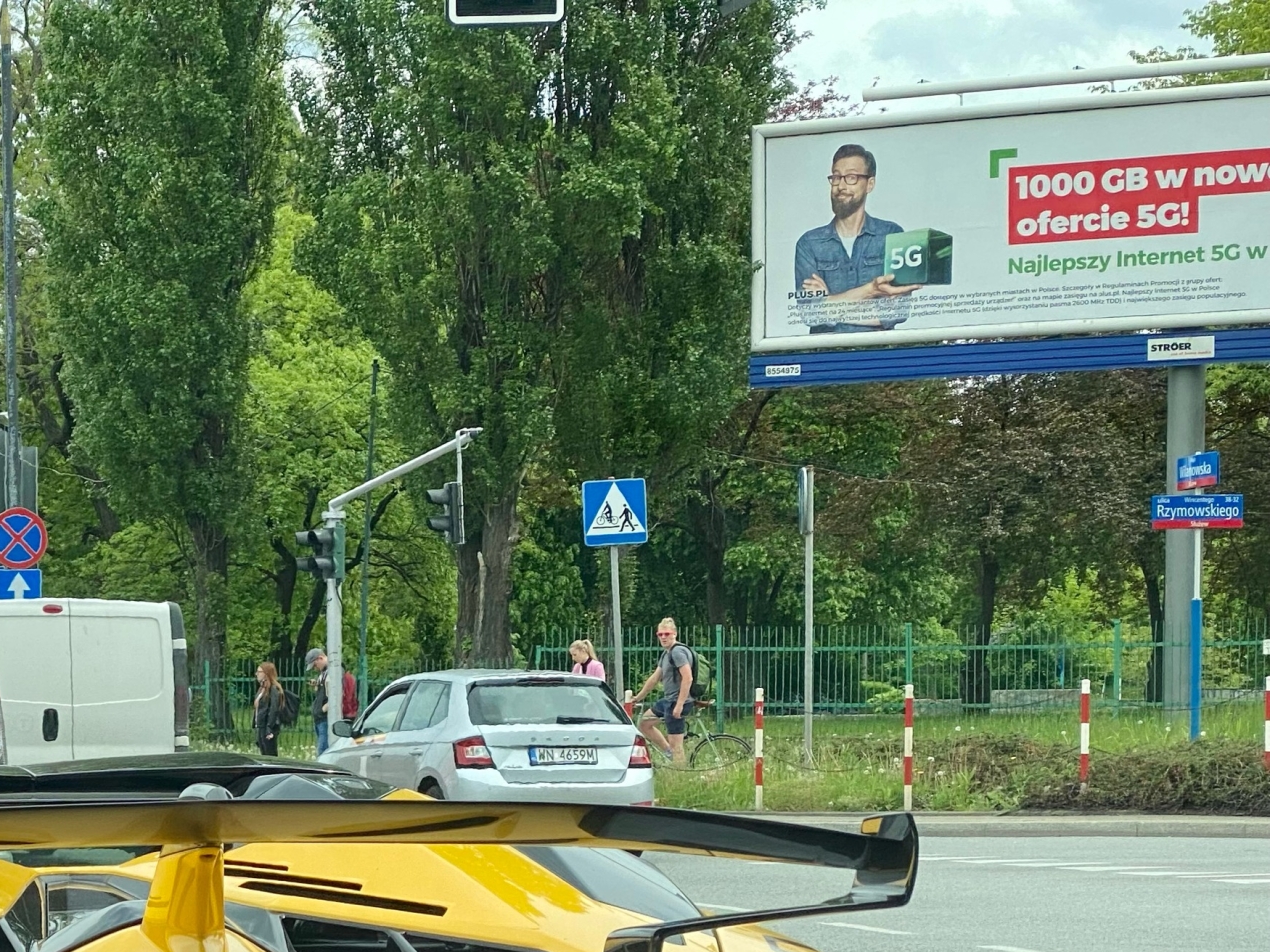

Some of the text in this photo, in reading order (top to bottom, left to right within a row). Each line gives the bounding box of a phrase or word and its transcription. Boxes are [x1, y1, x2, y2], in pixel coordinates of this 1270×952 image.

[1015, 162, 1270, 200] 1000 GB w now
[1016, 201, 1190, 237] ofercie 5G!
[890, 245, 923, 270] 5G
[1007, 243, 1269, 277] Najlepszy Internet 5G w
[787, 289, 829, 300] PLUS.PL
[1150, 342, 1192, 352] STRÖER
[1156, 503, 1240, 520] Rzymowskiego
[538, 748, 595, 761] WN 4659M
